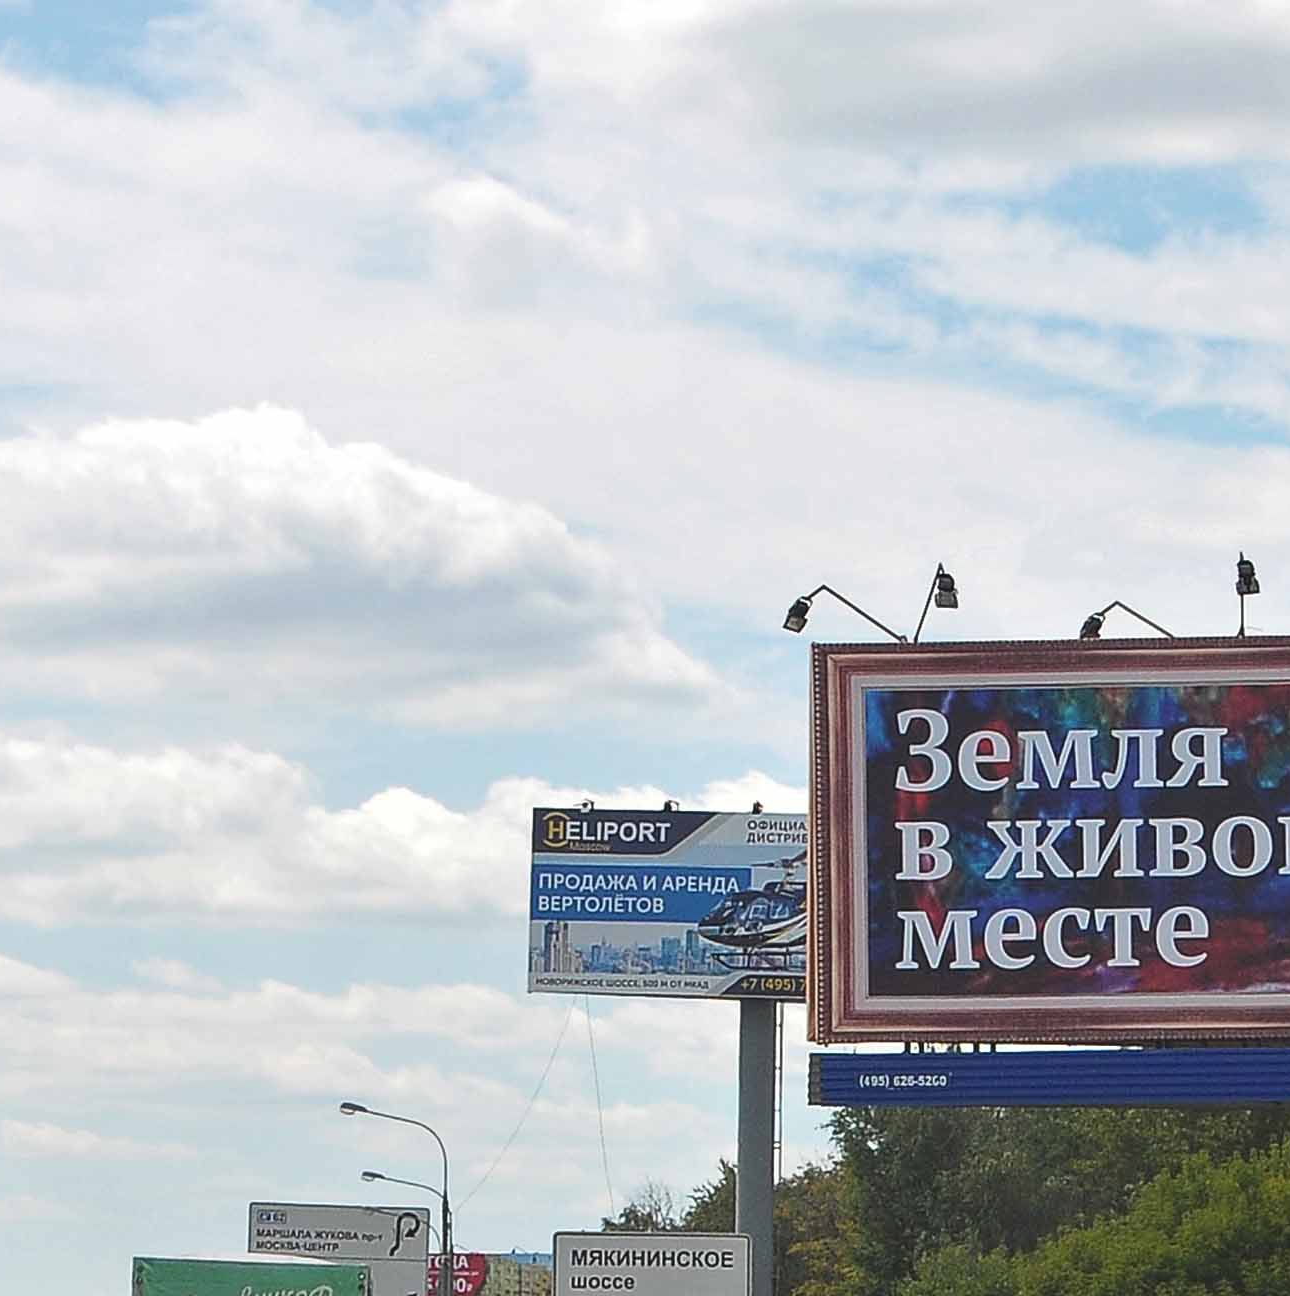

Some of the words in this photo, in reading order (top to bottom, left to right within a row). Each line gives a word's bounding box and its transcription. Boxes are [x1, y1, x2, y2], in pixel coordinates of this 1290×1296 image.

[894, 708, 1229, 792] Земля
[547, 819, 671, 844] HELIPORT
[895, 820, 953, 881] в
[538, 873, 637, 892] ПРОДАЖА
[643, 876, 657, 891] И
[662, 877, 740, 895] АРЕНДА
[538, 894, 664, 914] ВЕРТОЛЁТОВ
[896, 905, 1209, 971] месте
[760, 978, 795, 993] (495)
[256, 1228, 312, 1239] МАРШАЛА
[315, 1231, 358, 1241] ЖУКОВА
[256, 1240, 339, 1251] МОСКВА-ЦЕНТР
[571, 1249, 734, 1268] МЯКИНИНСКОЕ
[571, 1276, 635, 1290] шоссе
